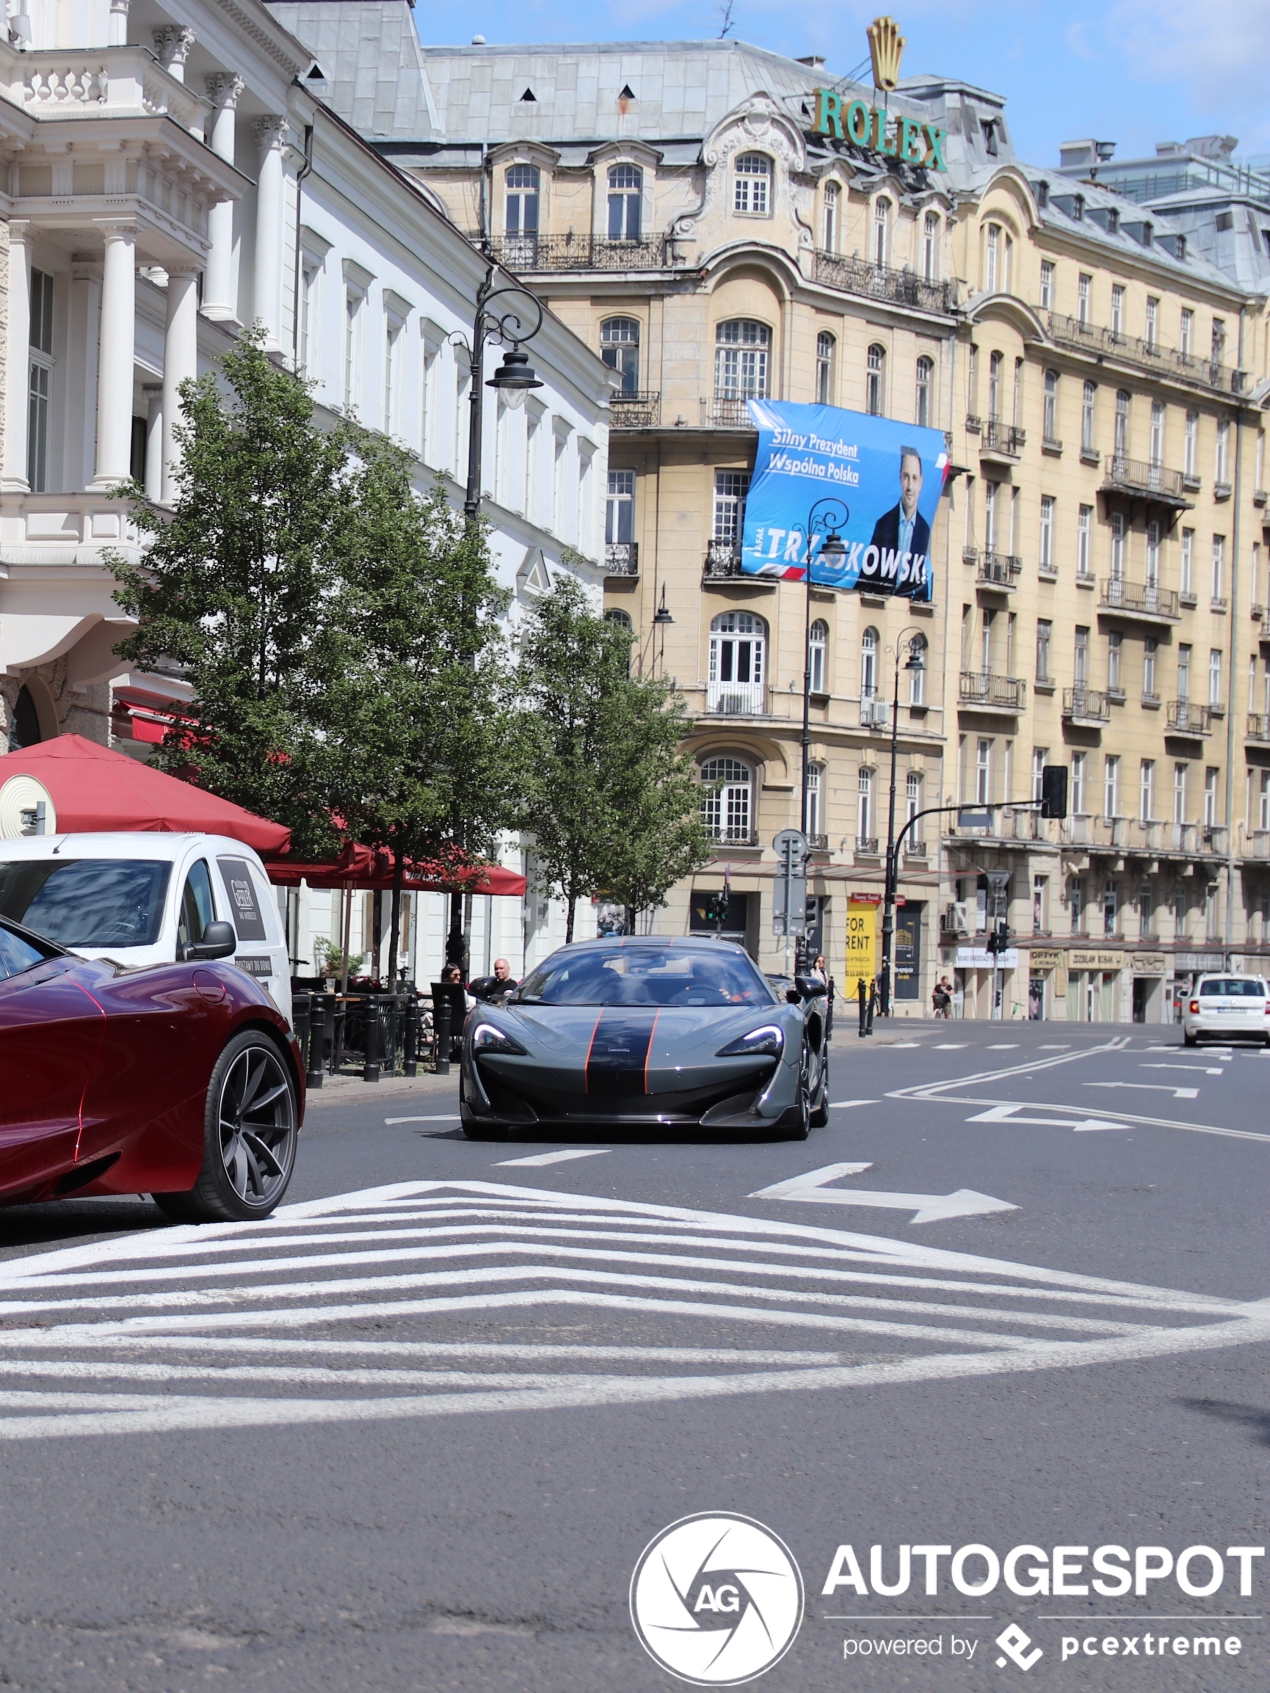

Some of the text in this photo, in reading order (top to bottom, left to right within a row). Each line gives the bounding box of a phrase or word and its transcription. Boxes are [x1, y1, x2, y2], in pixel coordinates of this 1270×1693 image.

[813, 88, 947, 172] ROLEX
[772, 428, 858, 458] Silny Prezydent
[770, 453, 859, 484] Wspólna Polska
[846, 936, 870, 950] RENT
[1032, 951, 1059, 959] OPTYK
